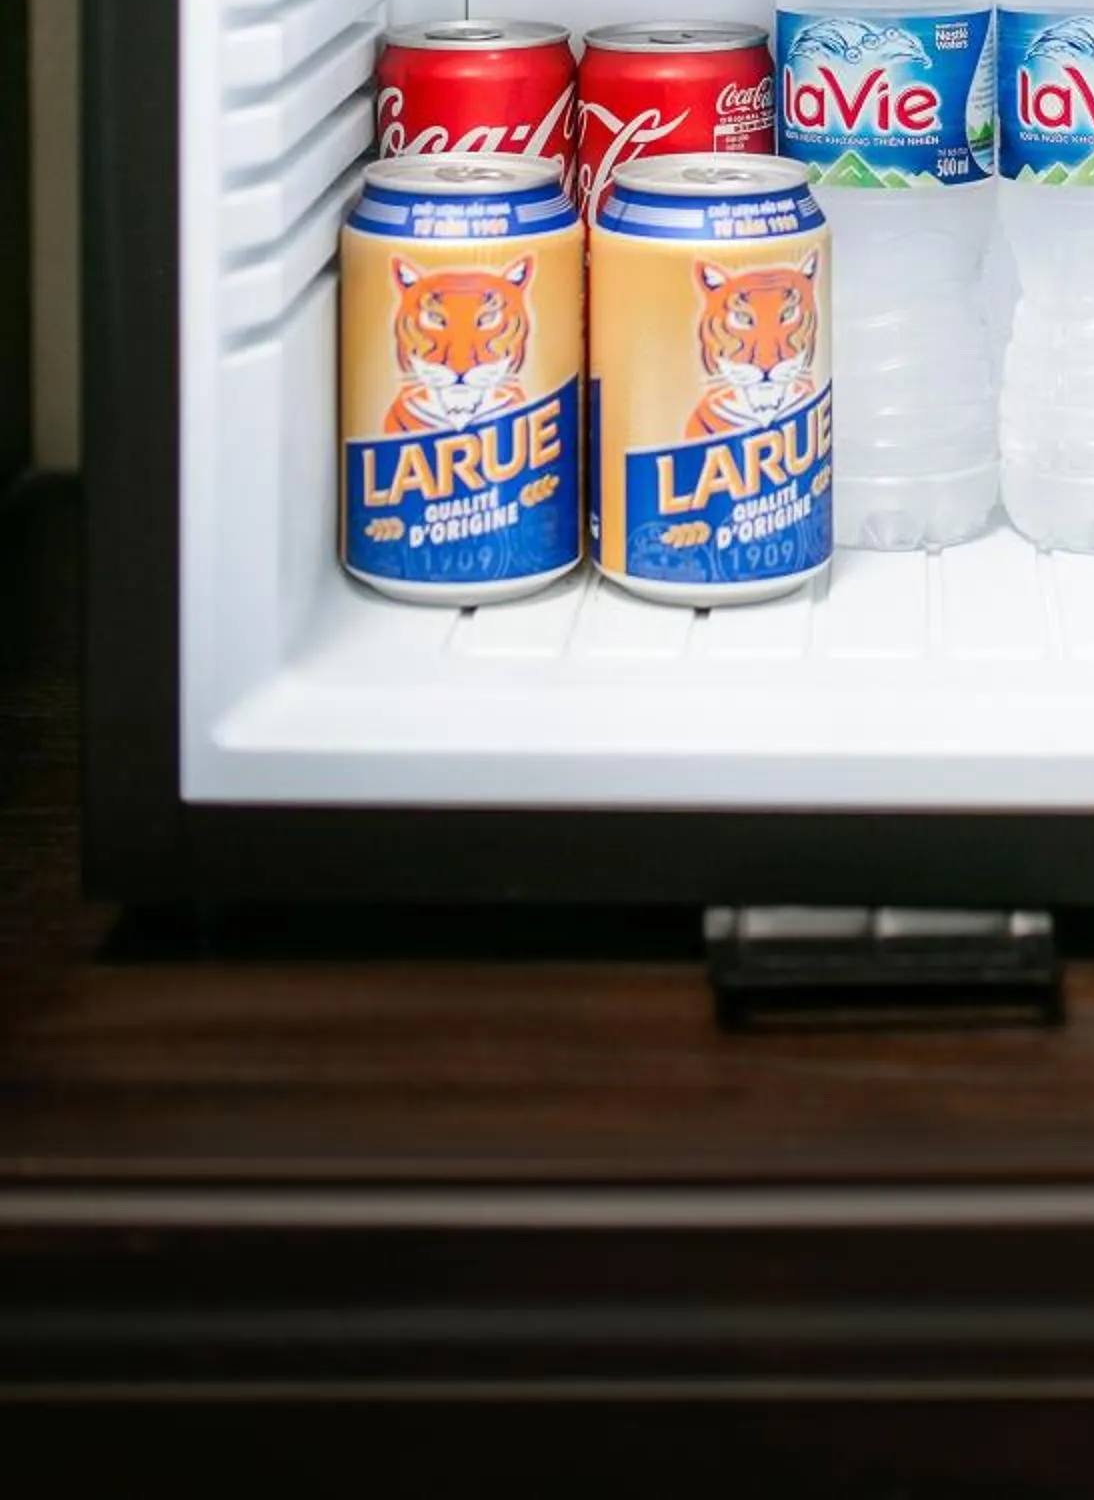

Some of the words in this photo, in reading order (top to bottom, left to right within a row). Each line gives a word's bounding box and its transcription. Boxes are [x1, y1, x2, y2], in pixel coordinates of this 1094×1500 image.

[784, 66, 937, 131] laVie
[361, 399, 561, 507] LARUE
[656, 390, 831, 516] LARUE
[409, 503, 520, 549] D'ORIGINE
[424, 484, 500, 524] QUALITÉ
[716, 493, 812, 550] D'ORIGINE
[733, 479, 799, 523] QUALITÉ
[728, 541, 796, 570] 1909
